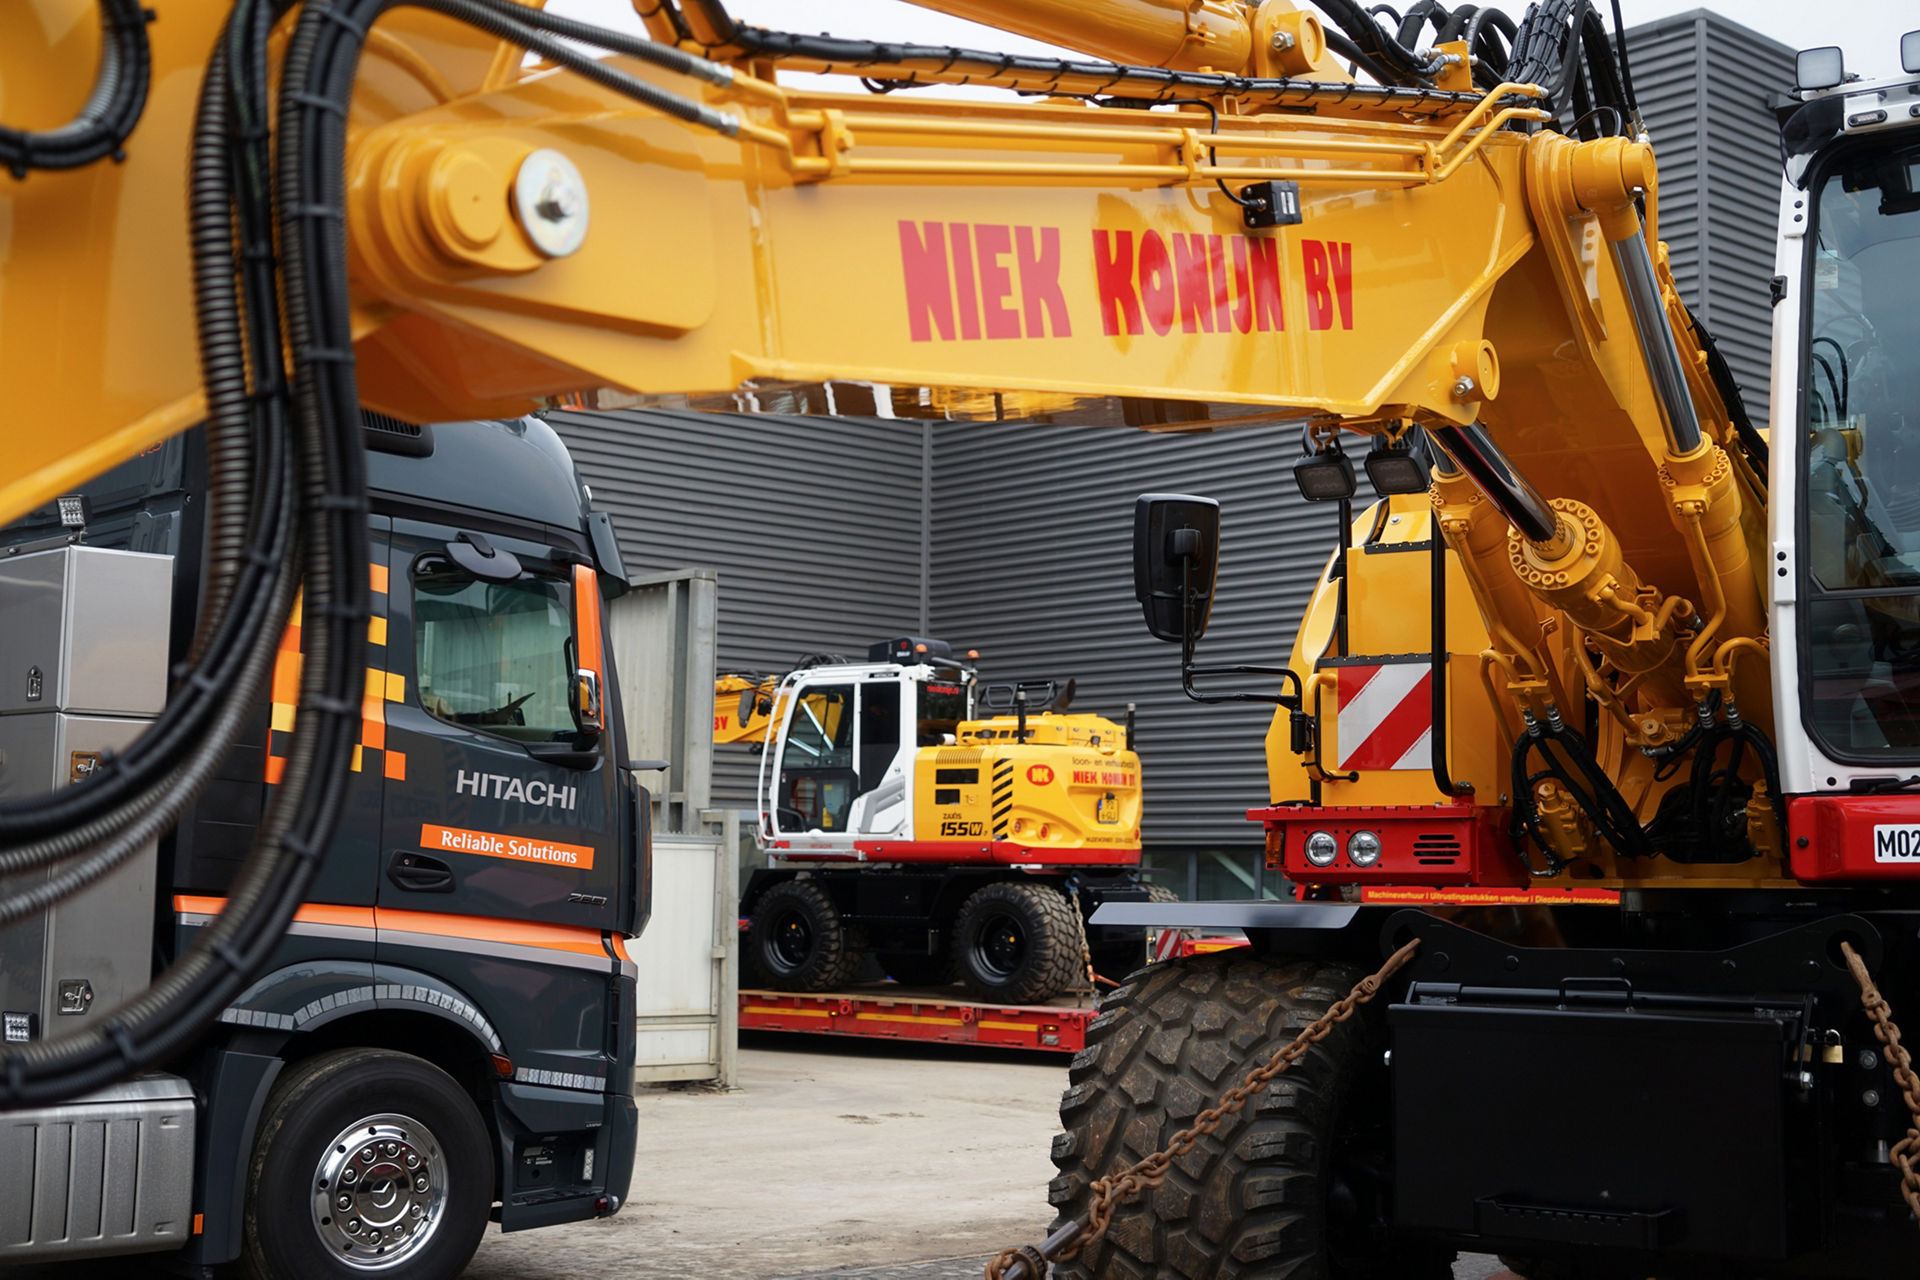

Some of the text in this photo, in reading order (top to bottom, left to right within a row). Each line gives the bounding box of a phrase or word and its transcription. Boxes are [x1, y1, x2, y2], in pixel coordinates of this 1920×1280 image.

[898, 220, 1353, 342] NIEK KONIJN BV
[714, 716, 728, 730] BV
[456, 769, 577, 810] HITACHI
[1073, 771, 1097, 784] NIEK
[941, 822, 983, 836] 155W
[441, 830, 578, 864] Reliable Solutions
[1877, 830, 1920, 857] M02
